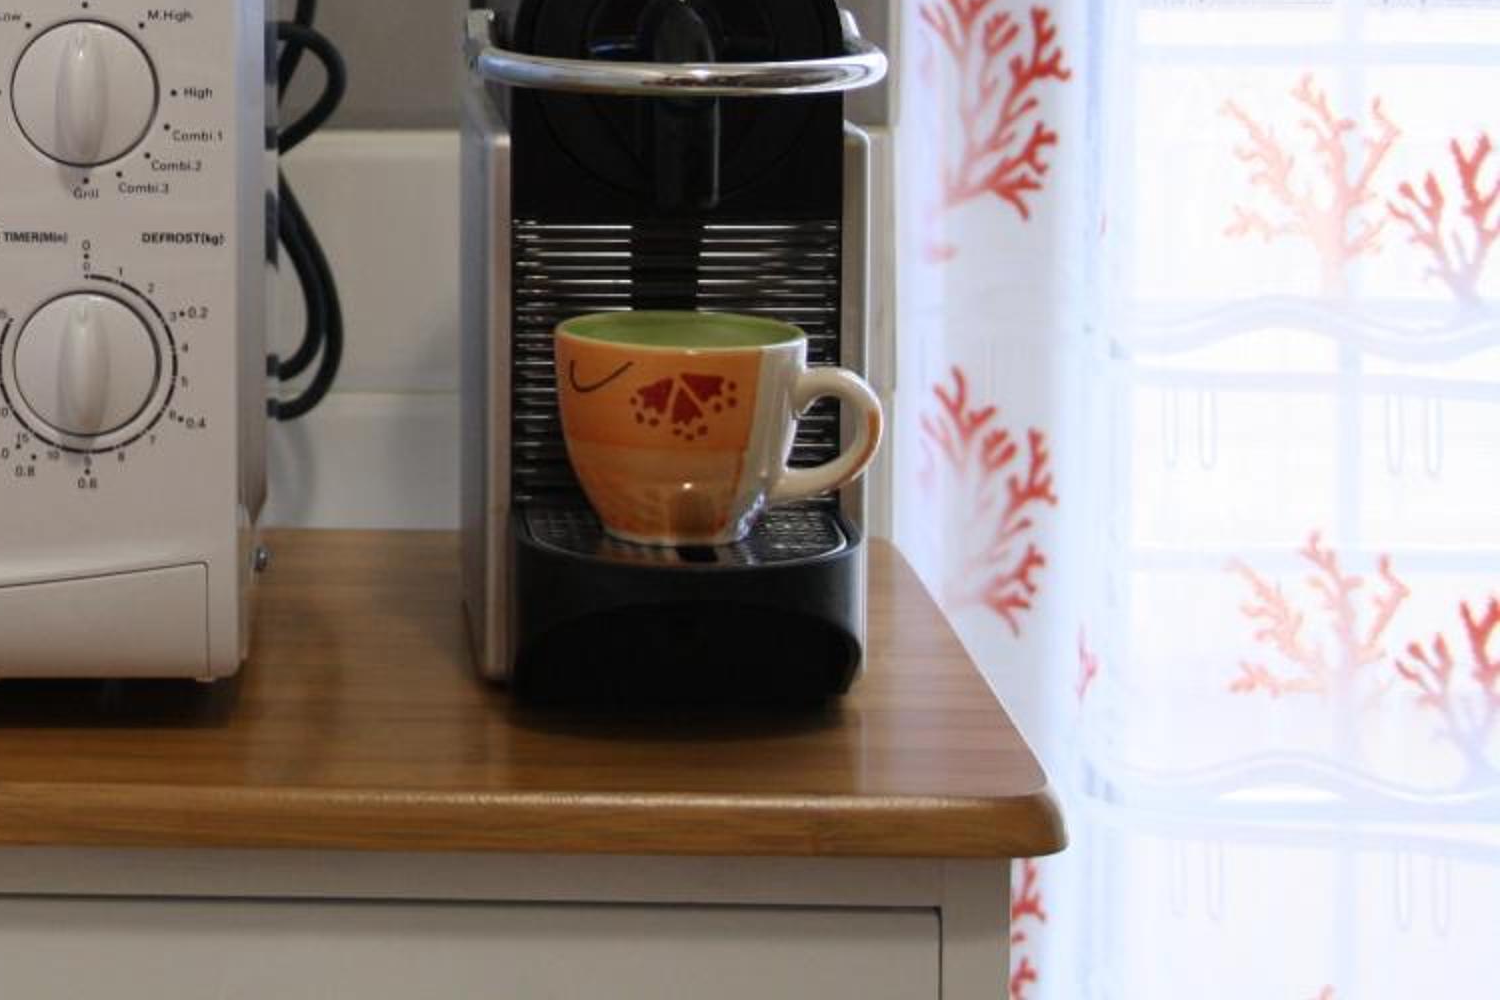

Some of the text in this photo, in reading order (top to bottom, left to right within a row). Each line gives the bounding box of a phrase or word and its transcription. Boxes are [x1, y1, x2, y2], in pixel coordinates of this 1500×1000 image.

[183, 87, 213, 101] High
[73, 186, 100, 199] Grill
[142, 231, 225, 246] DEFROST(kg)
[186, 306, 209, 319] 0.2
